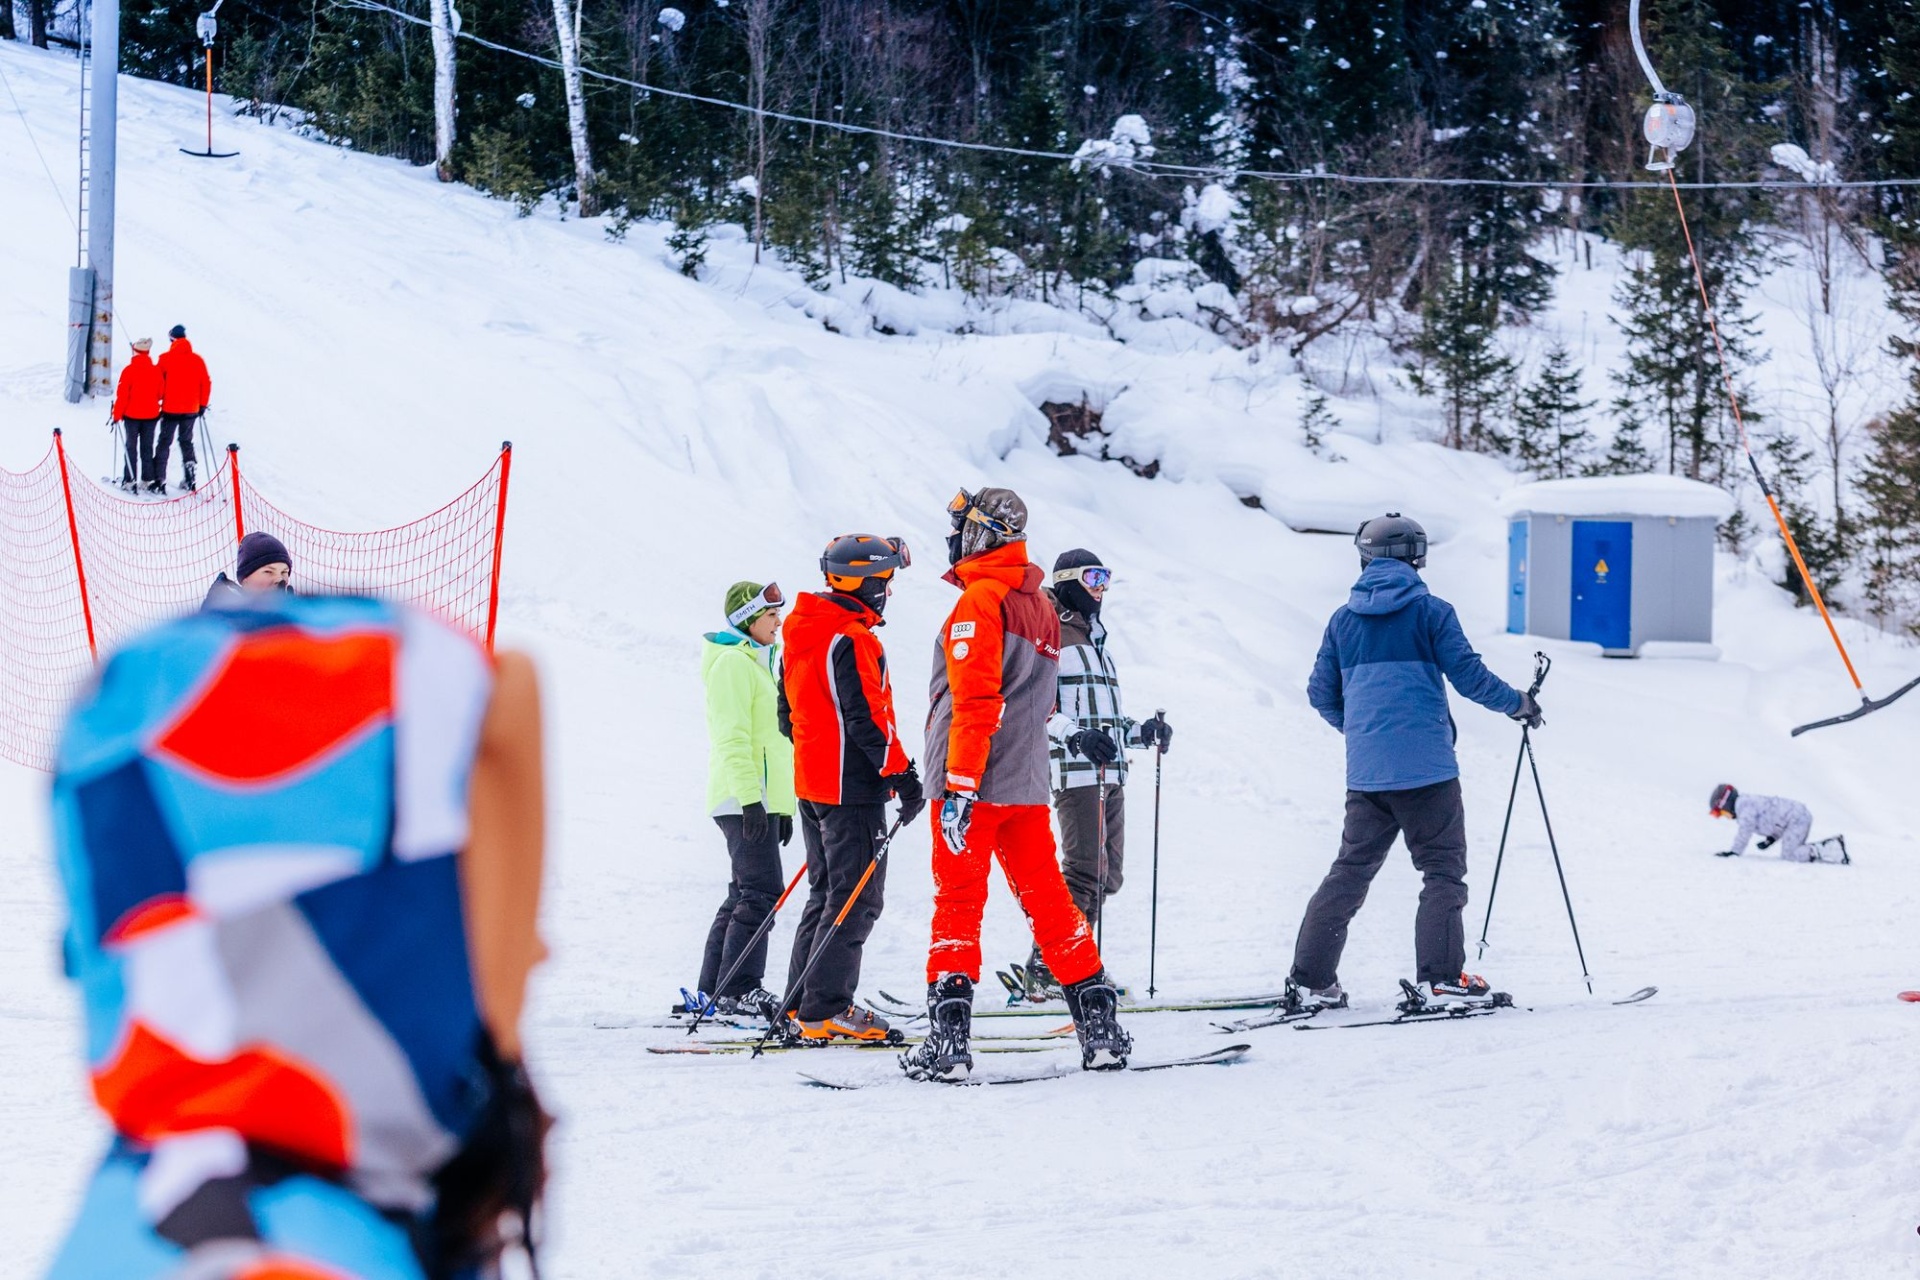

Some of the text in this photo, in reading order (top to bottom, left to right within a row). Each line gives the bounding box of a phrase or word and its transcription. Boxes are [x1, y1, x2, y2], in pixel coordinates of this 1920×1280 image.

[735, 603, 756, 620] SMITH
[876, 836, 890, 860] LEKI
[1433, 982, 1469, 994] NORDICA
[1090, 1040, 1113, 1048] DRAKE
[948, 1054, 970, 1062] DRAKE
